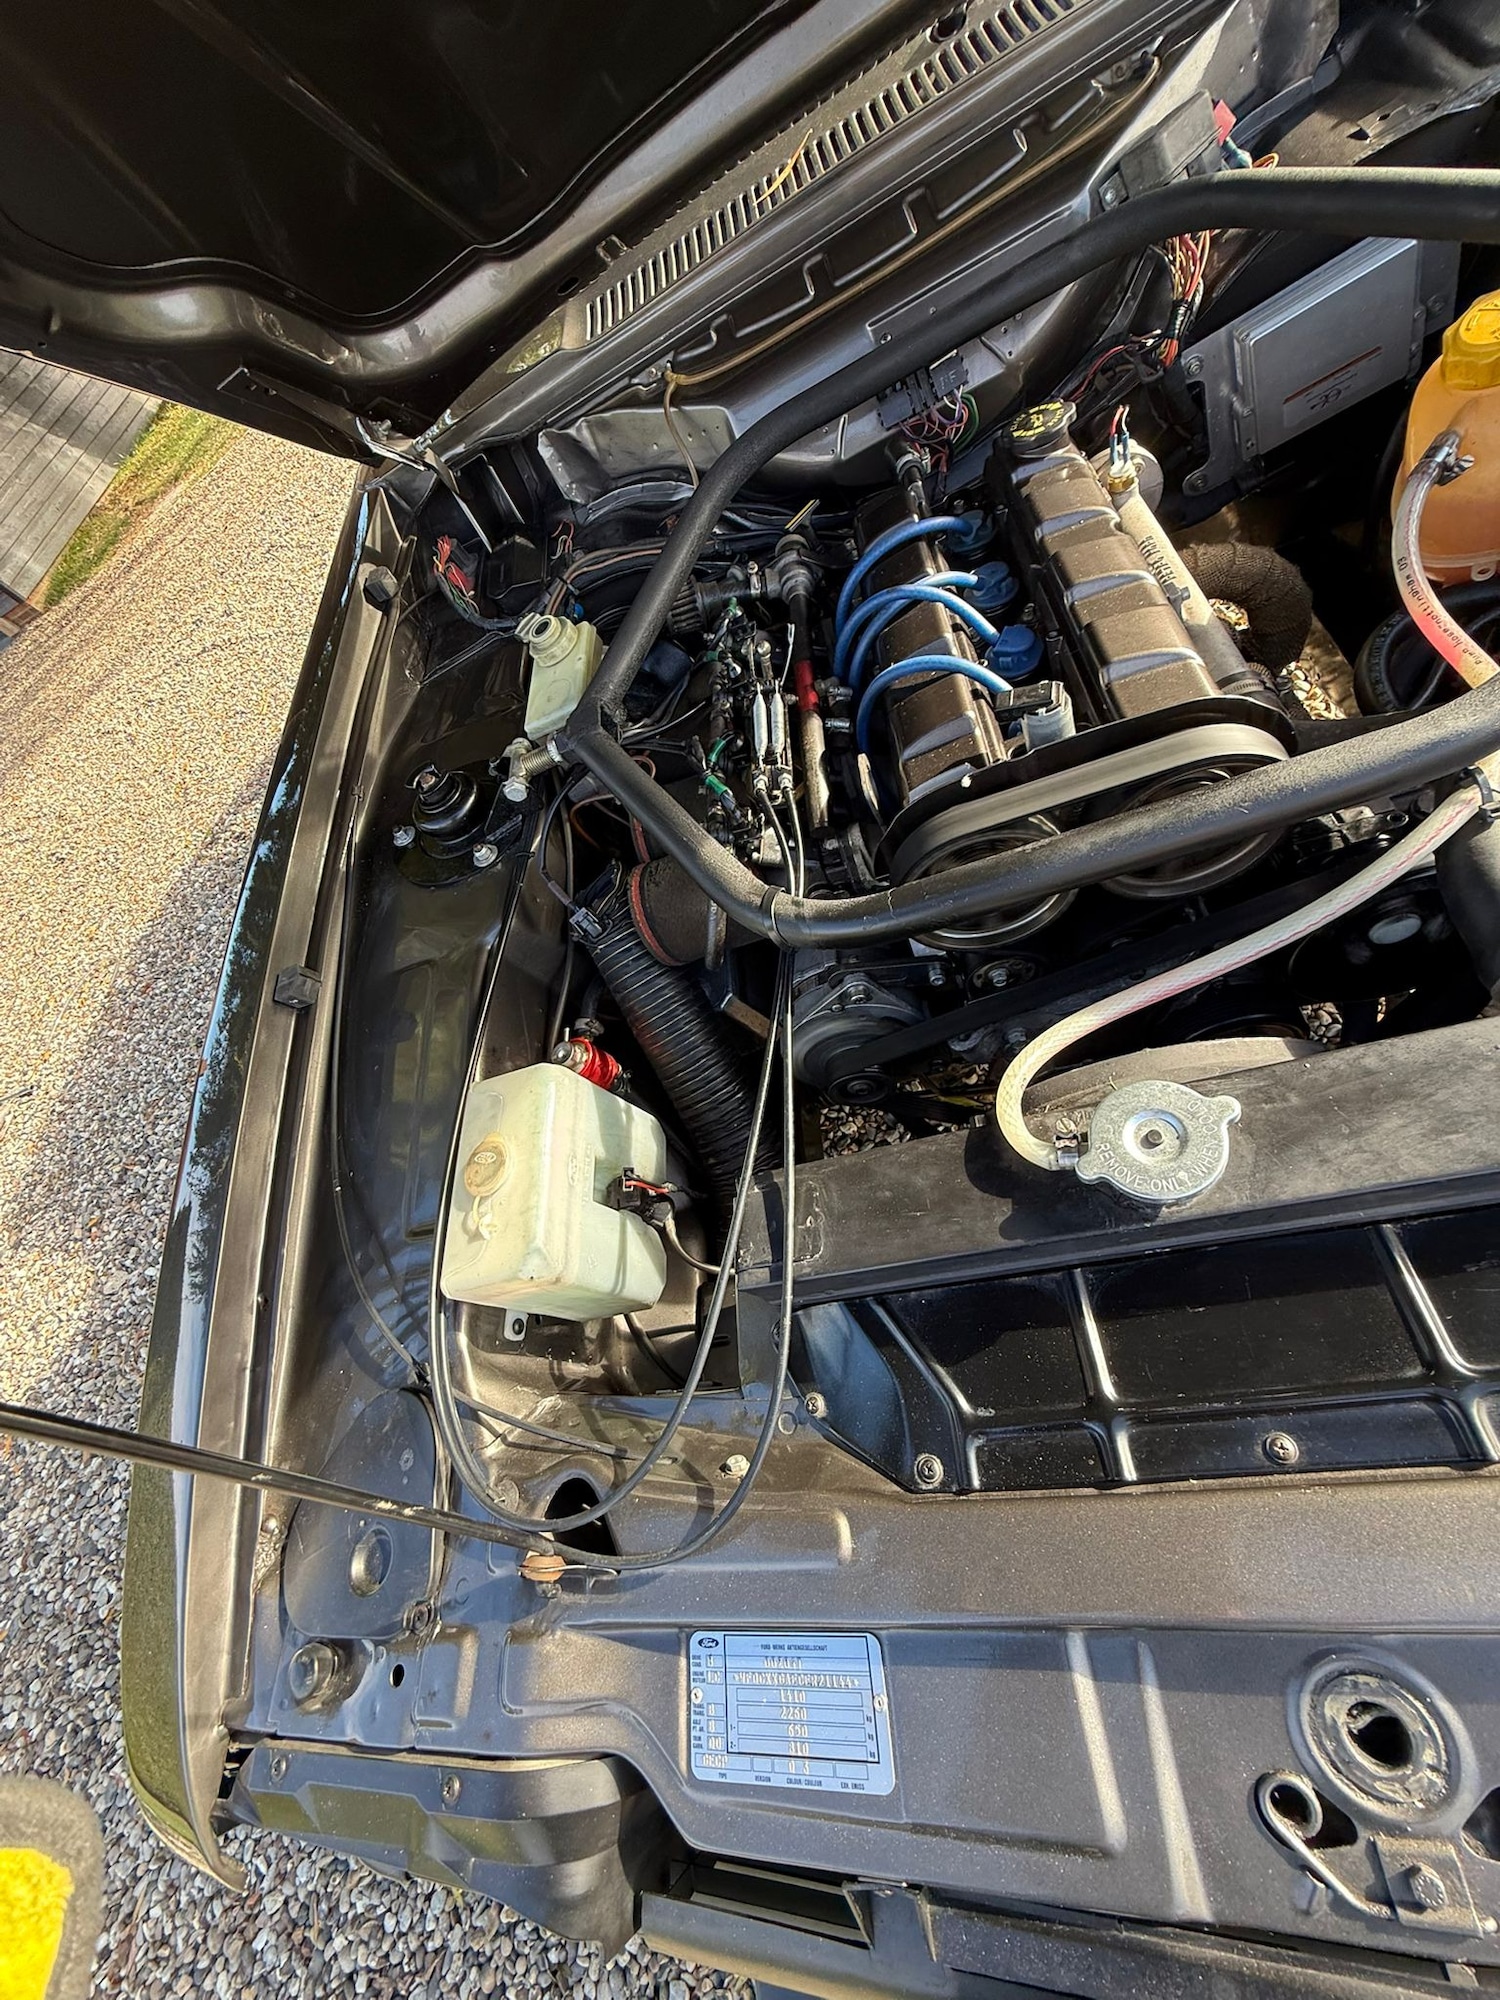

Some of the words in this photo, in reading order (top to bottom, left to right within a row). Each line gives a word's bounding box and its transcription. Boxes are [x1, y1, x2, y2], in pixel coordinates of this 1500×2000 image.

[1187, 1099, 1218, 1134] COLD
[1096, 1142, 1147, 1189] REMOVE
[1192, 1142, 1220, 1177] WHEN
[1150, 1172, 1192, 1192] ONLY
